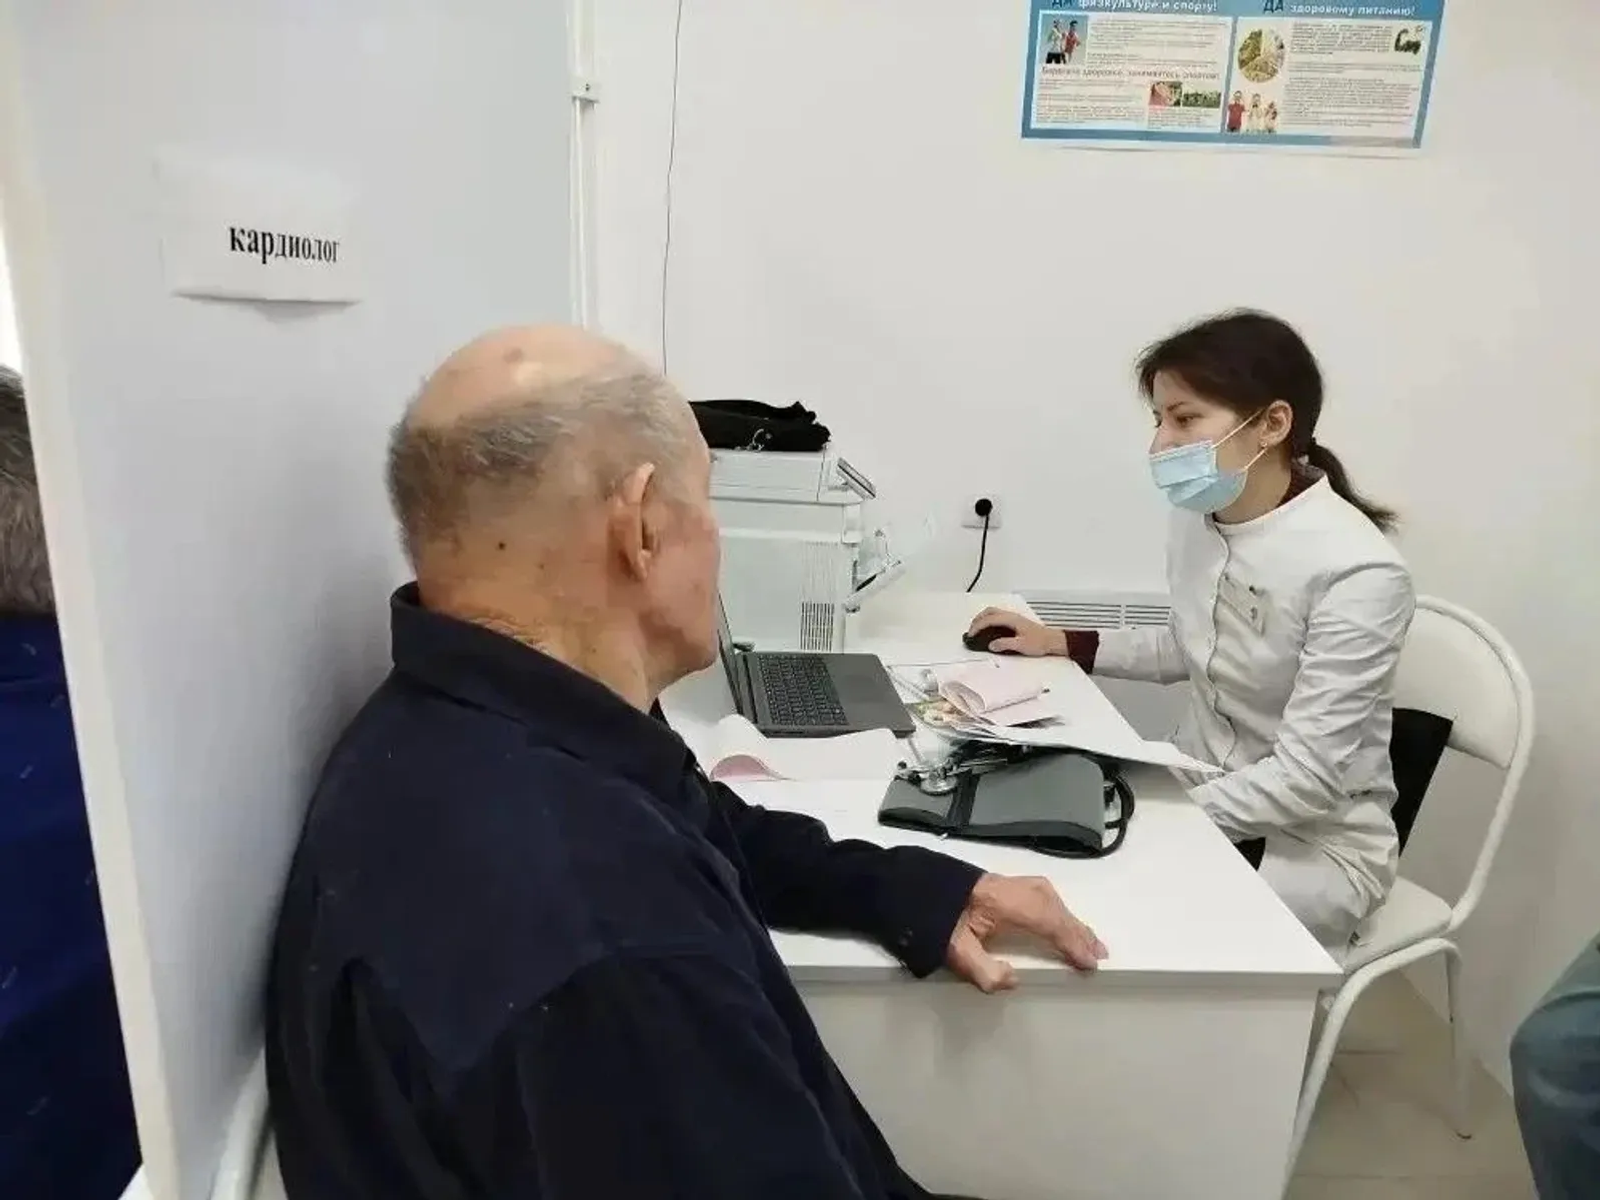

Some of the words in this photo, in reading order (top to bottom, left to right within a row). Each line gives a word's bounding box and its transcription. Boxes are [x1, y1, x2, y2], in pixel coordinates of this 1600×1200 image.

[1173, 1, 1217, 13] спорту!
[1263, 0, 1284, 14] ДА
[1290, 4, 1354, 17] здоровому
[1357, 5, 1415, 17] питанию!
[229, 226, 340, 265] кардиолог
